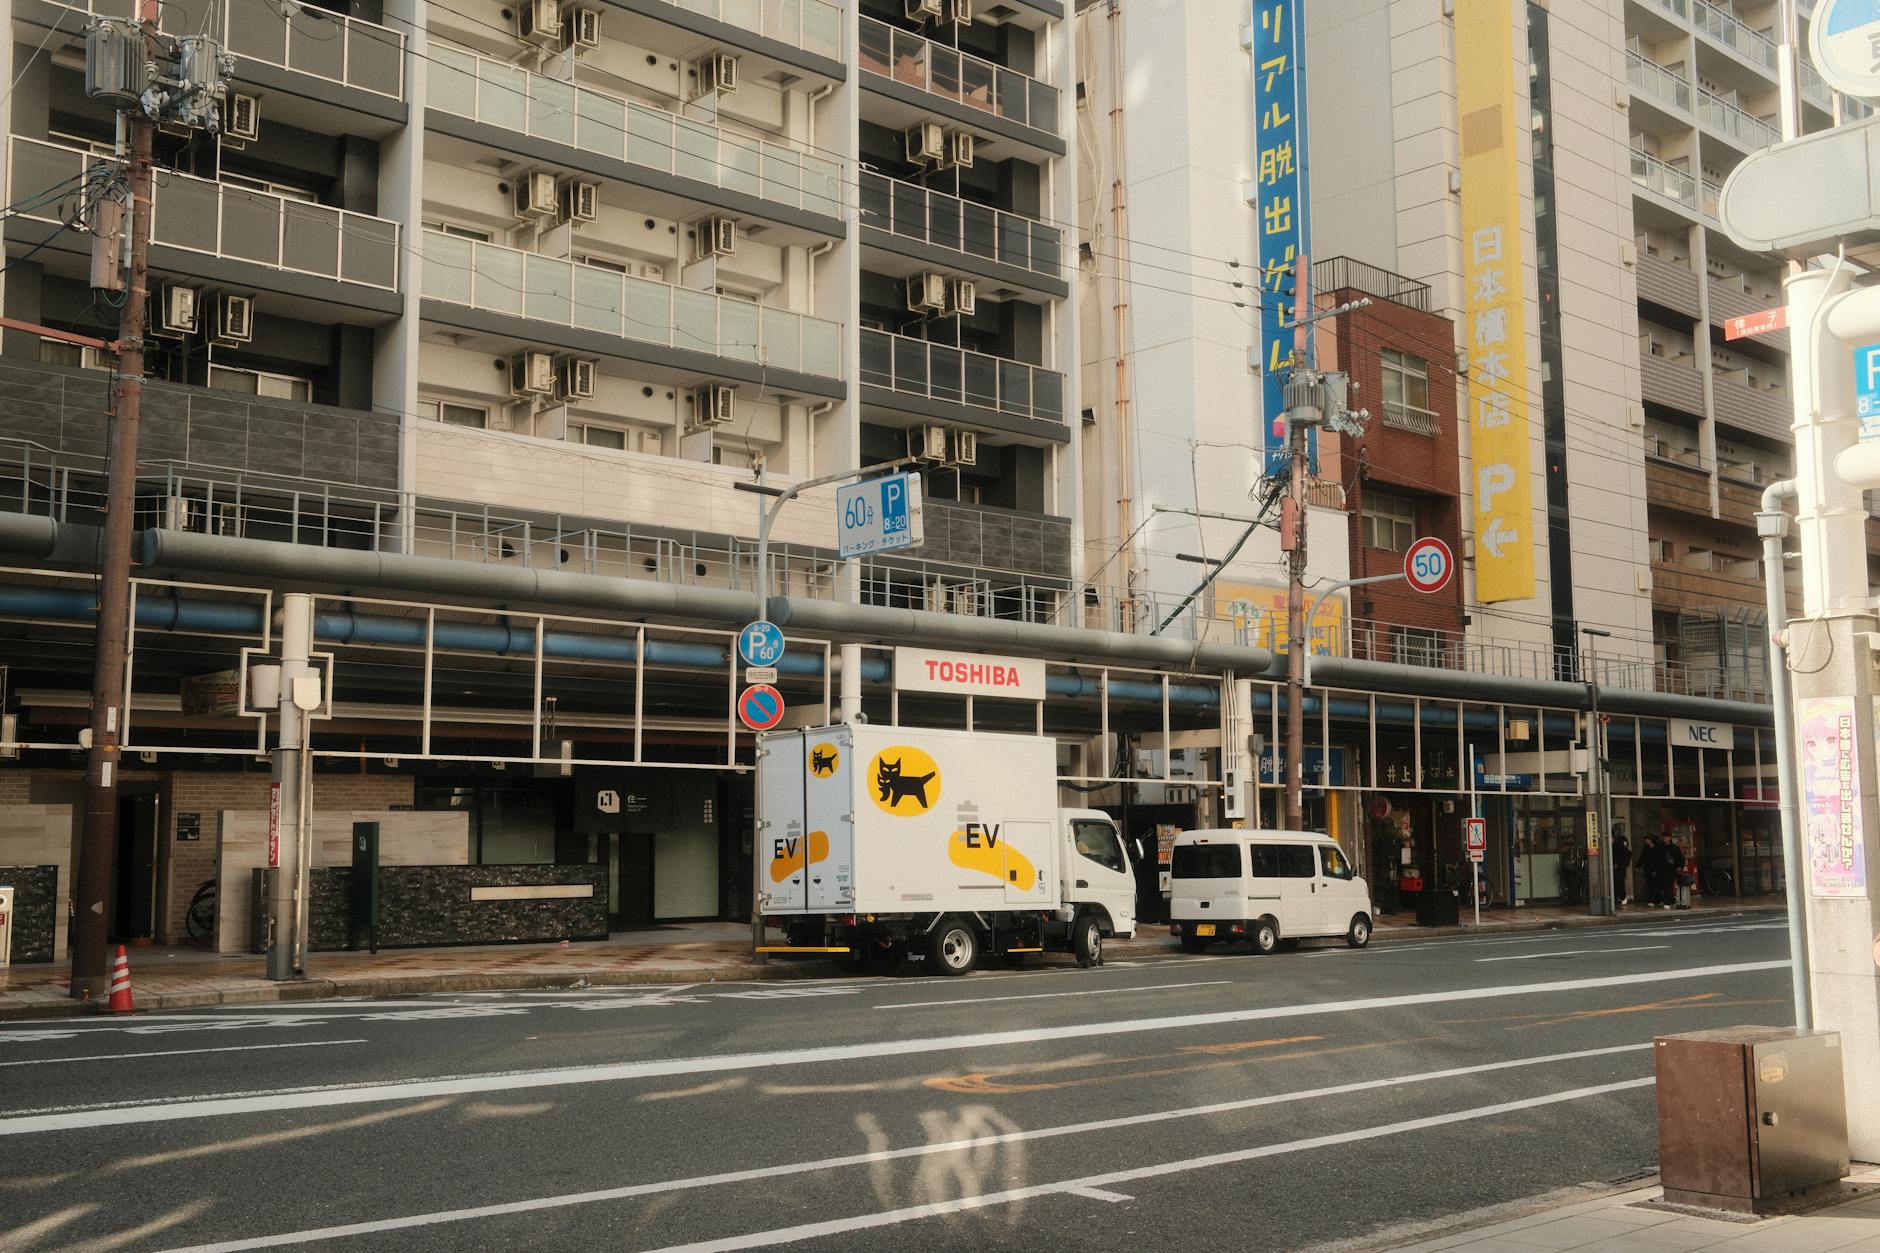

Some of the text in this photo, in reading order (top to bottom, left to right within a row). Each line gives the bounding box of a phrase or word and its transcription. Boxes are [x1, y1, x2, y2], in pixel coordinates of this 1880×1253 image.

[1472, 225, 1509, 429] 日本橋本店
[887, 483, 901, 514] P
[1480, 463, 1516, 513] P
[845, 495, 874, 529] 60分
[884, 515, 906, 531] 8-20
[1415, 552, 1441, 578] 50
[754, 624, 771, 632] 8-20
[748, 631, 765, 660] P
[925, 660, 1020, 687] TOSHIBA
[1688, 725, 1717, 743] NEC
[774, 838, 797, 859] EV
[966, 823, 1000, 849] EV
